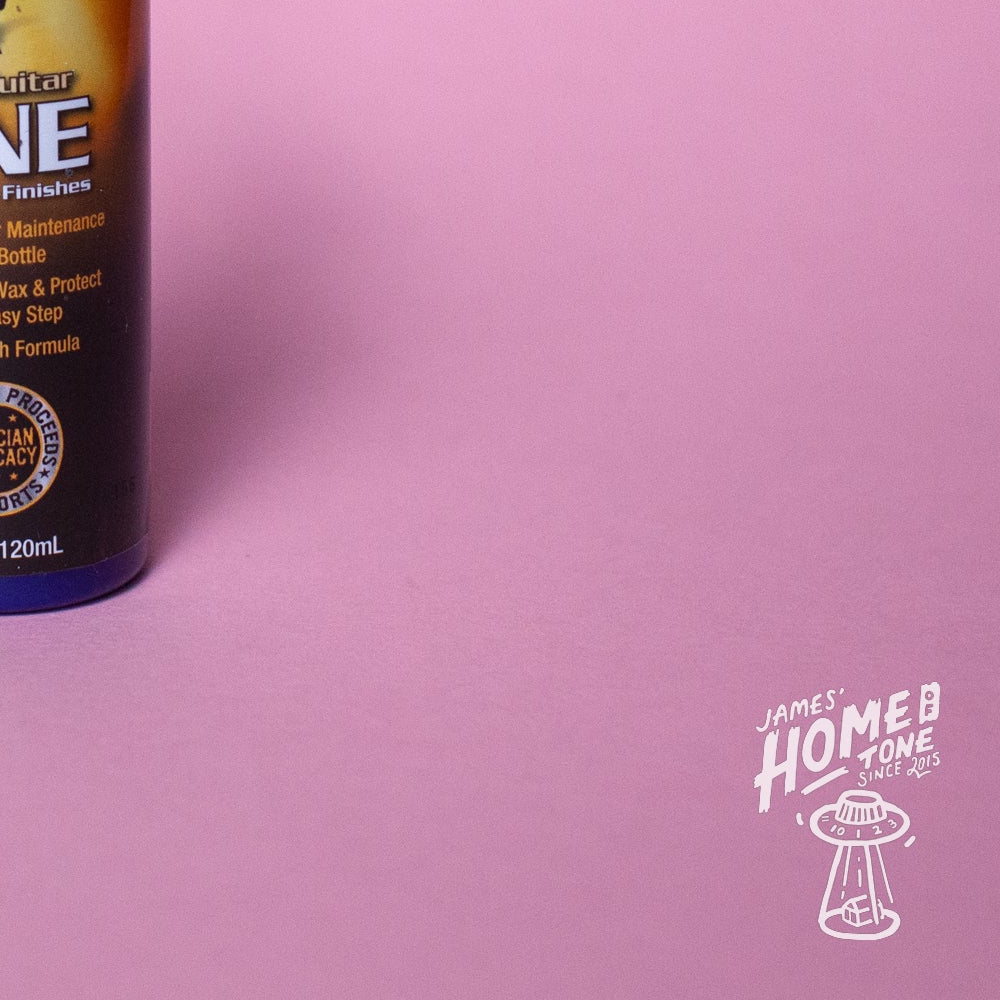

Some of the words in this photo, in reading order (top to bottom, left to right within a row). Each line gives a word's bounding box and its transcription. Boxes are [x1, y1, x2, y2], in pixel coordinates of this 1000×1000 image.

[2, 178, 92, 200] Finishes
[7, 211, 105, 239] Maintenance
[33, 279, 46, 296] &
[50, 269, 103, 294] Protect
[26, 305, 64, 325] Step
[15, 334, 81, 357] Formula
[5, 387, 61, 468] PROCEEDS
